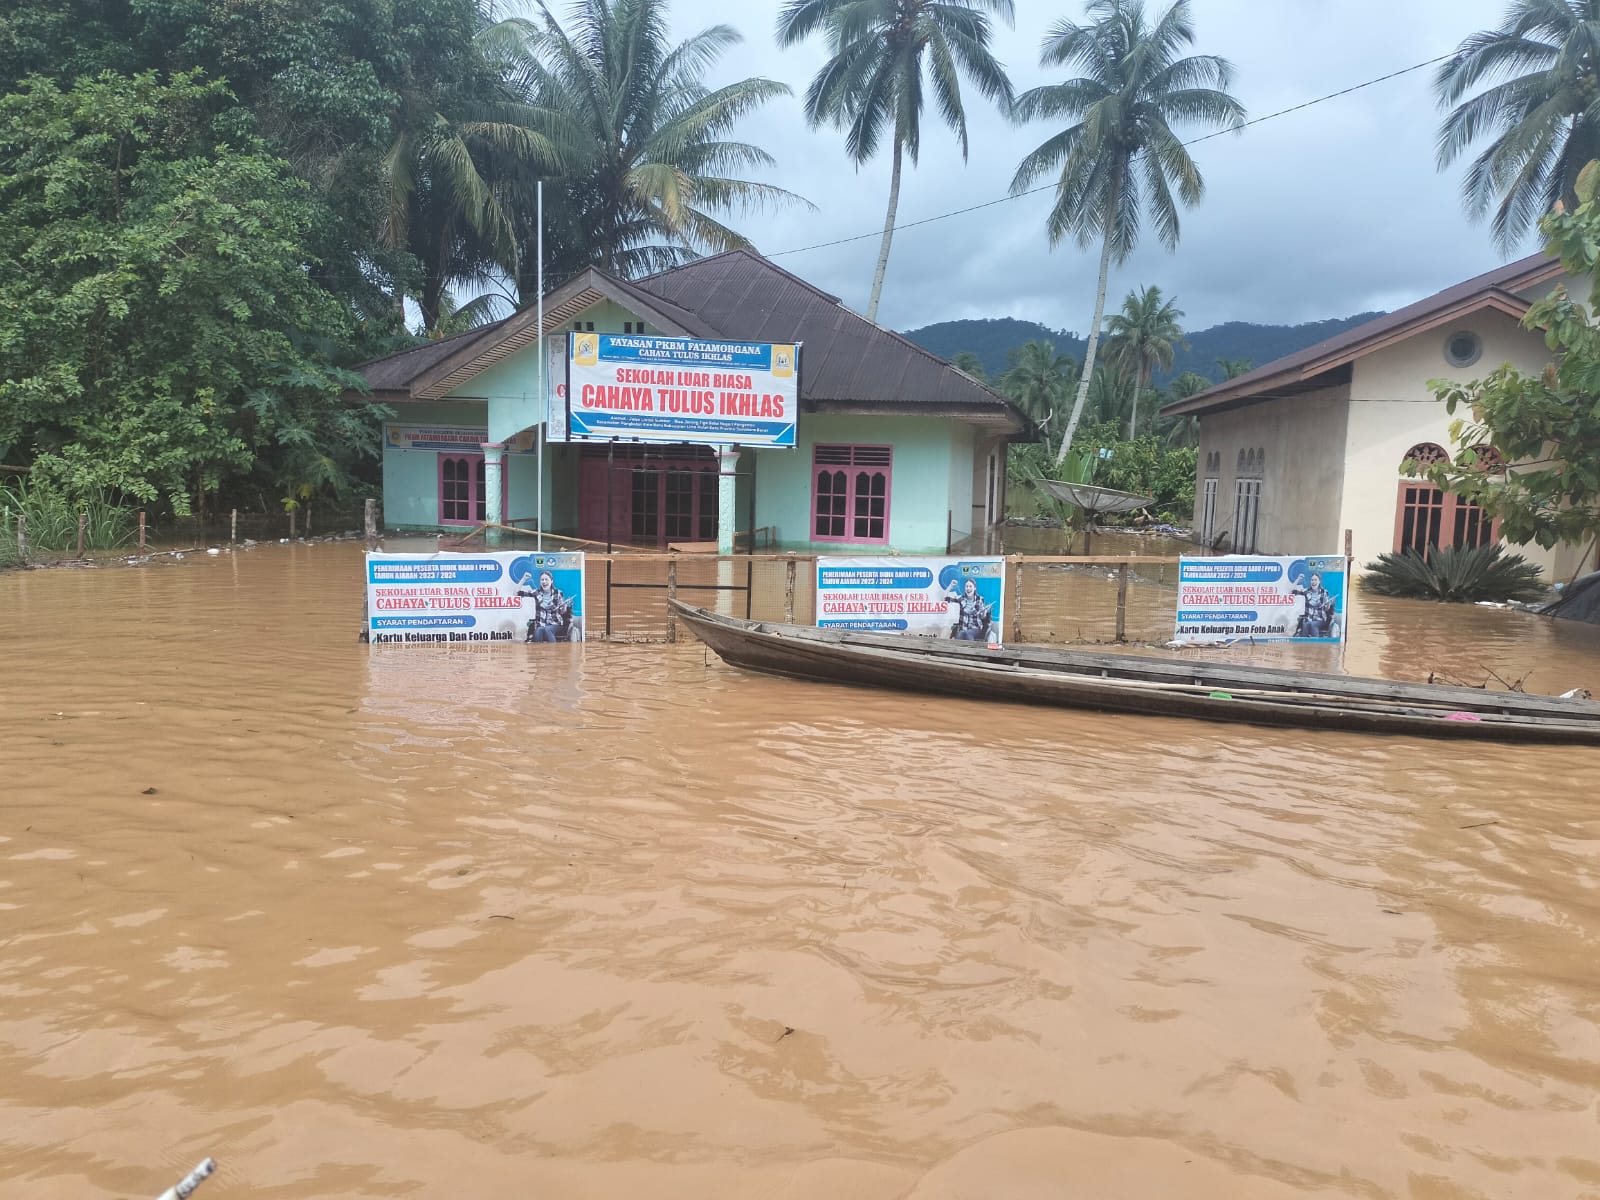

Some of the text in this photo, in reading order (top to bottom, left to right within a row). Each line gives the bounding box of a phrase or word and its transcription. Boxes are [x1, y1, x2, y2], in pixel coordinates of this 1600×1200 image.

[610, 338, 761, 354] YAYASAN PKBM FATAMORGANA
[639, 349, 671, 358] CAHAYA
[673, 351, 699, 359] TULUS
[701, 352, 732, 361] IKHLAS
[616, 368, 752, 389] SEKOLAH LUAR BIASA
[582, 384, 653, 411] CAHAYA
[657, 389, 715, 414] TULUS
[720, 392, 784, 417] IKHLAS
[376, 588, 417, 596] SEKOLAH
[419, 588, 441, 596] LUAR
[376, 597, 521, 609] CAHAYA TULUS IKHLAS
[1182, 595, 1294, 604] CAHAYA TULUS IKHLAS
[823, 602, 948, 612] CAHAYA TULUS IKHLAS
[1180, 625, 1285, 634] Kartu Keluarga Dan Foto Anak
[377, 630, 513, 643] Kartu Keluarga Dan Foto Anak
